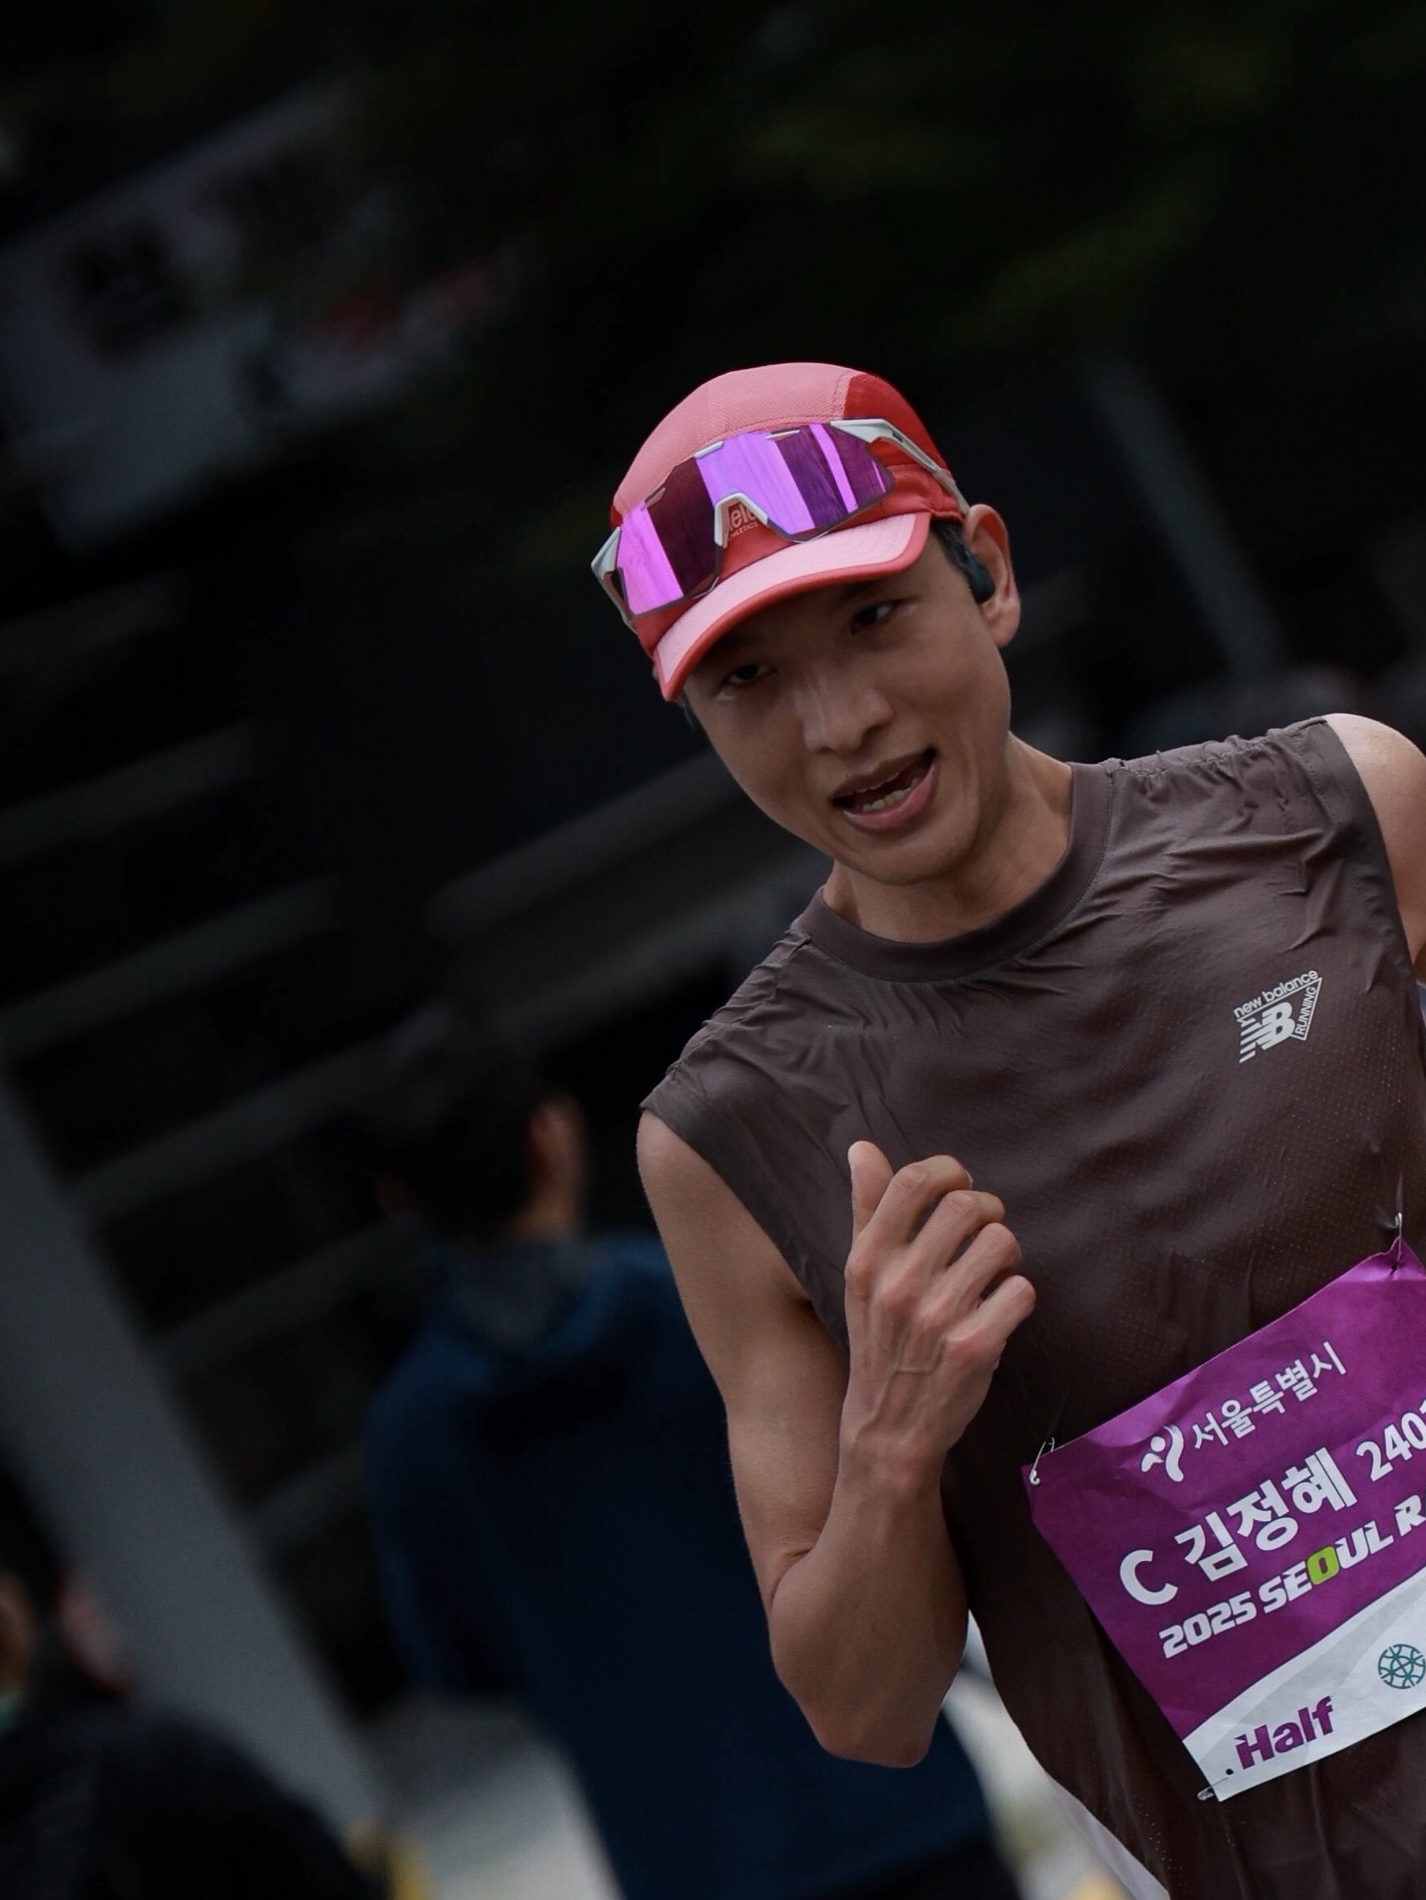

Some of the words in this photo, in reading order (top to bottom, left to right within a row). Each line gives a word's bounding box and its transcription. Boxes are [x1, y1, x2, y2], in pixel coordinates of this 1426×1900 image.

[1233, 997, 1262, 1018] new
[1262, 970, 1318, 1003] balance
[1295, 986, 1317, 1035] RUNNING
[1191, 1341, 1347, 1452] 서울특별시
[1119, 1549, 1178, 1605] C
[1174, 1447, 1357, 1583] 김정혜
[1159, 1591, 1258, 1658] 2025
[1259, 1521, 1394, 1613] SEOUL
[1235, 1696, 1335, 1769] Half
